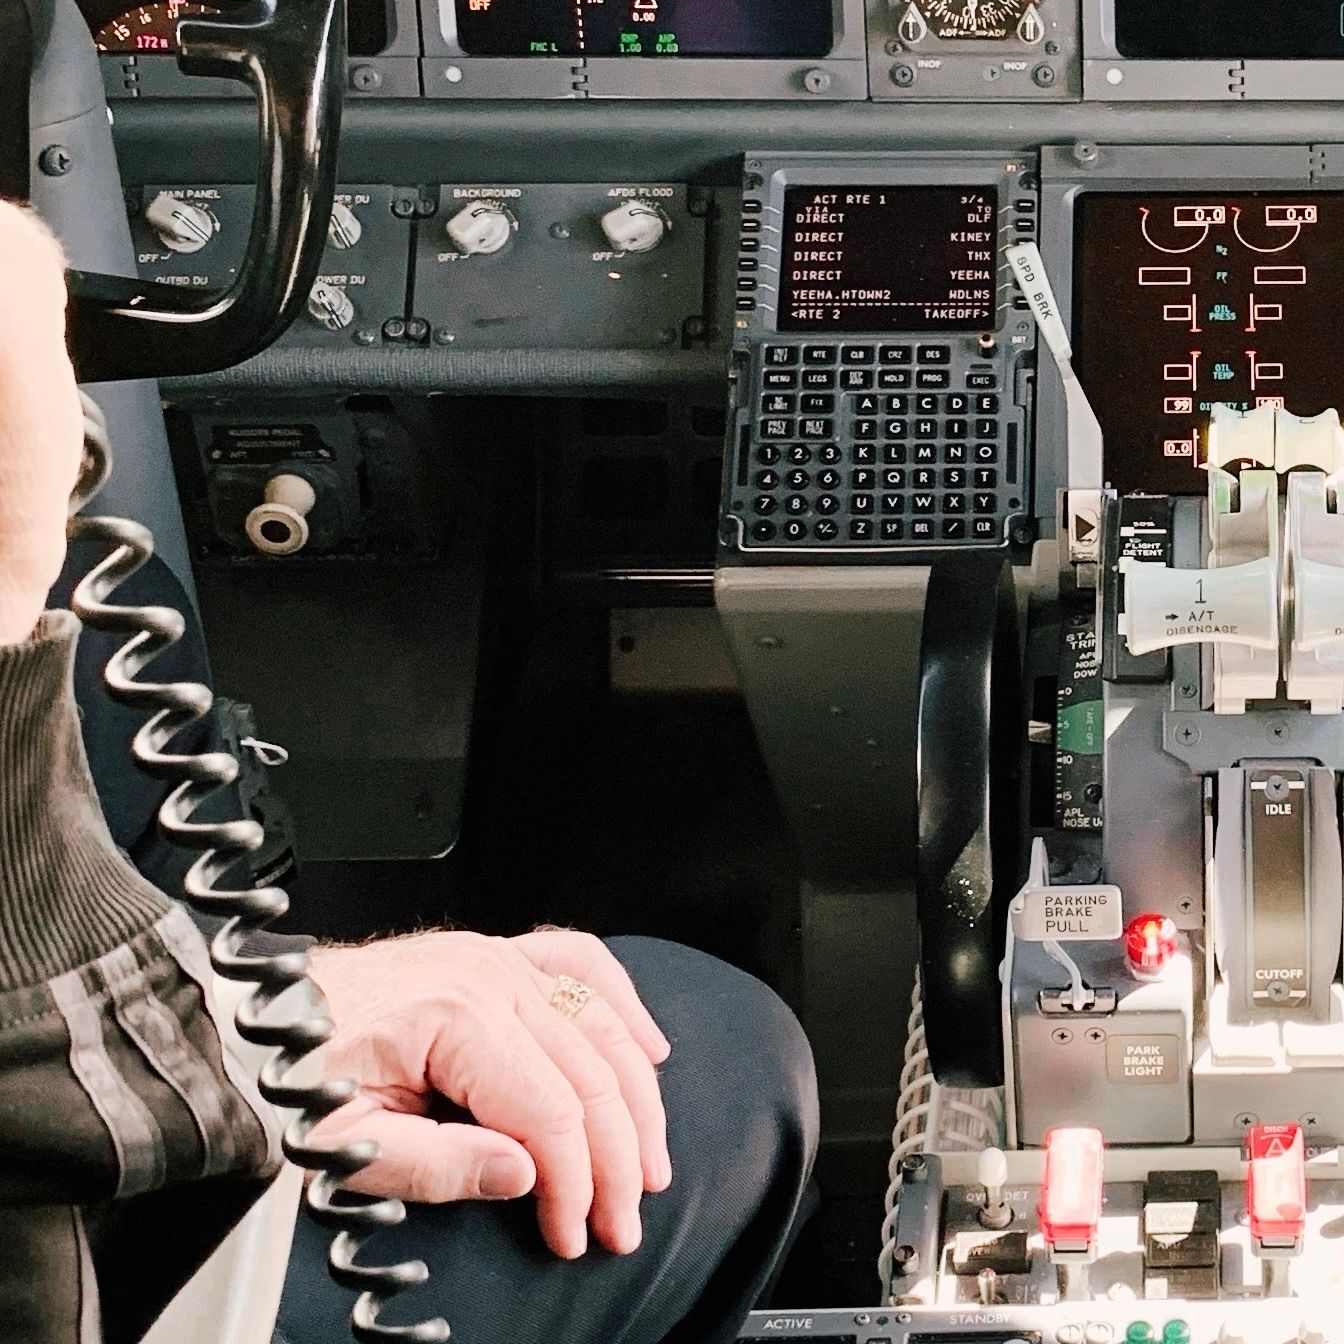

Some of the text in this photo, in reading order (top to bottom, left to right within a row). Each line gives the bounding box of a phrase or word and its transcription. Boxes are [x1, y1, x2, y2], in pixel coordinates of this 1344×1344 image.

[453, 188, 522, 199] BACKGROUND
[608, 187, 674, 198] AFDS FLOOD
[814, 195, 870, 204] ACT RTE
[796, 213, 991, 223] DIRECT DLF
[795, 233, 991, 242] DIRECT KINEY
[794, 252, 991, 261] DIRECT THX
[793, 271, 990, 280] DIRECT YEEHA
[1017, 256, 1053, 321] SPD BRK
[792, 290, 990, 300] YEEHA.HTOWN2 WDLNS
[1195, 579, 1206, 604] 1
[1189, 610, 1215, 623] A/T
[1166, 624, 1238, 637] DISENGAGE
[1264, 803, 1292, 816] IDLE
[1044, 895, 1107, 907] PARKING
[1044, 906, 1093, 918] BRAKE
[1045, 919, 1088, 934] PULL
[1255, 968, 1304, 980] CUTOFF
[1127, 1045, 1161, 1056] PARK
[1123, 1055, 1165, 1066] BRAKE
[1124, 1066, 1164, 1077] LIGHT
[764, 1318, 812, 1330] ACTIVE
[950, 1314, 1011, 1325] STANDBY
